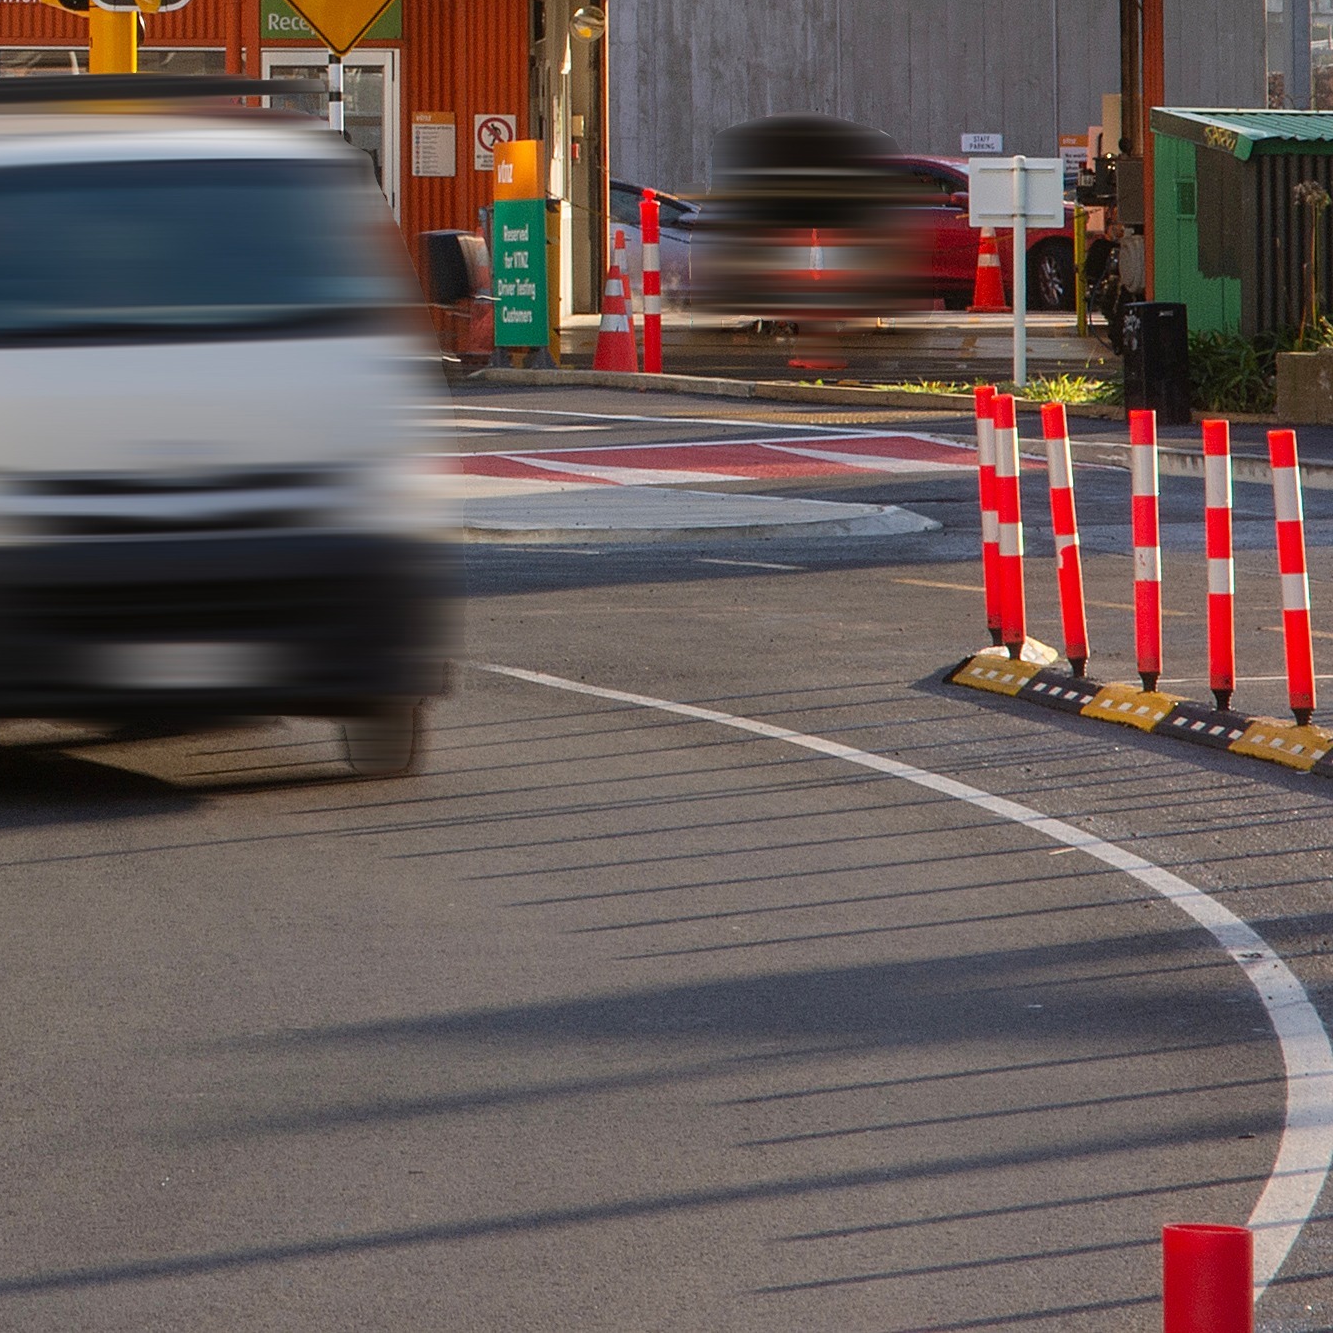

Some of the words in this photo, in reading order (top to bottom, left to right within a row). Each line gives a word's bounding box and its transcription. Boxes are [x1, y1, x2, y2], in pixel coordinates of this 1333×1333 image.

[503, 224, 529, 242] Reserved
[504, 251, 514, 269] for
[497, 279, 516, 297] Driver
[515, 277, 536, 301] Testing
[502, 306, 533, 324] Customers
